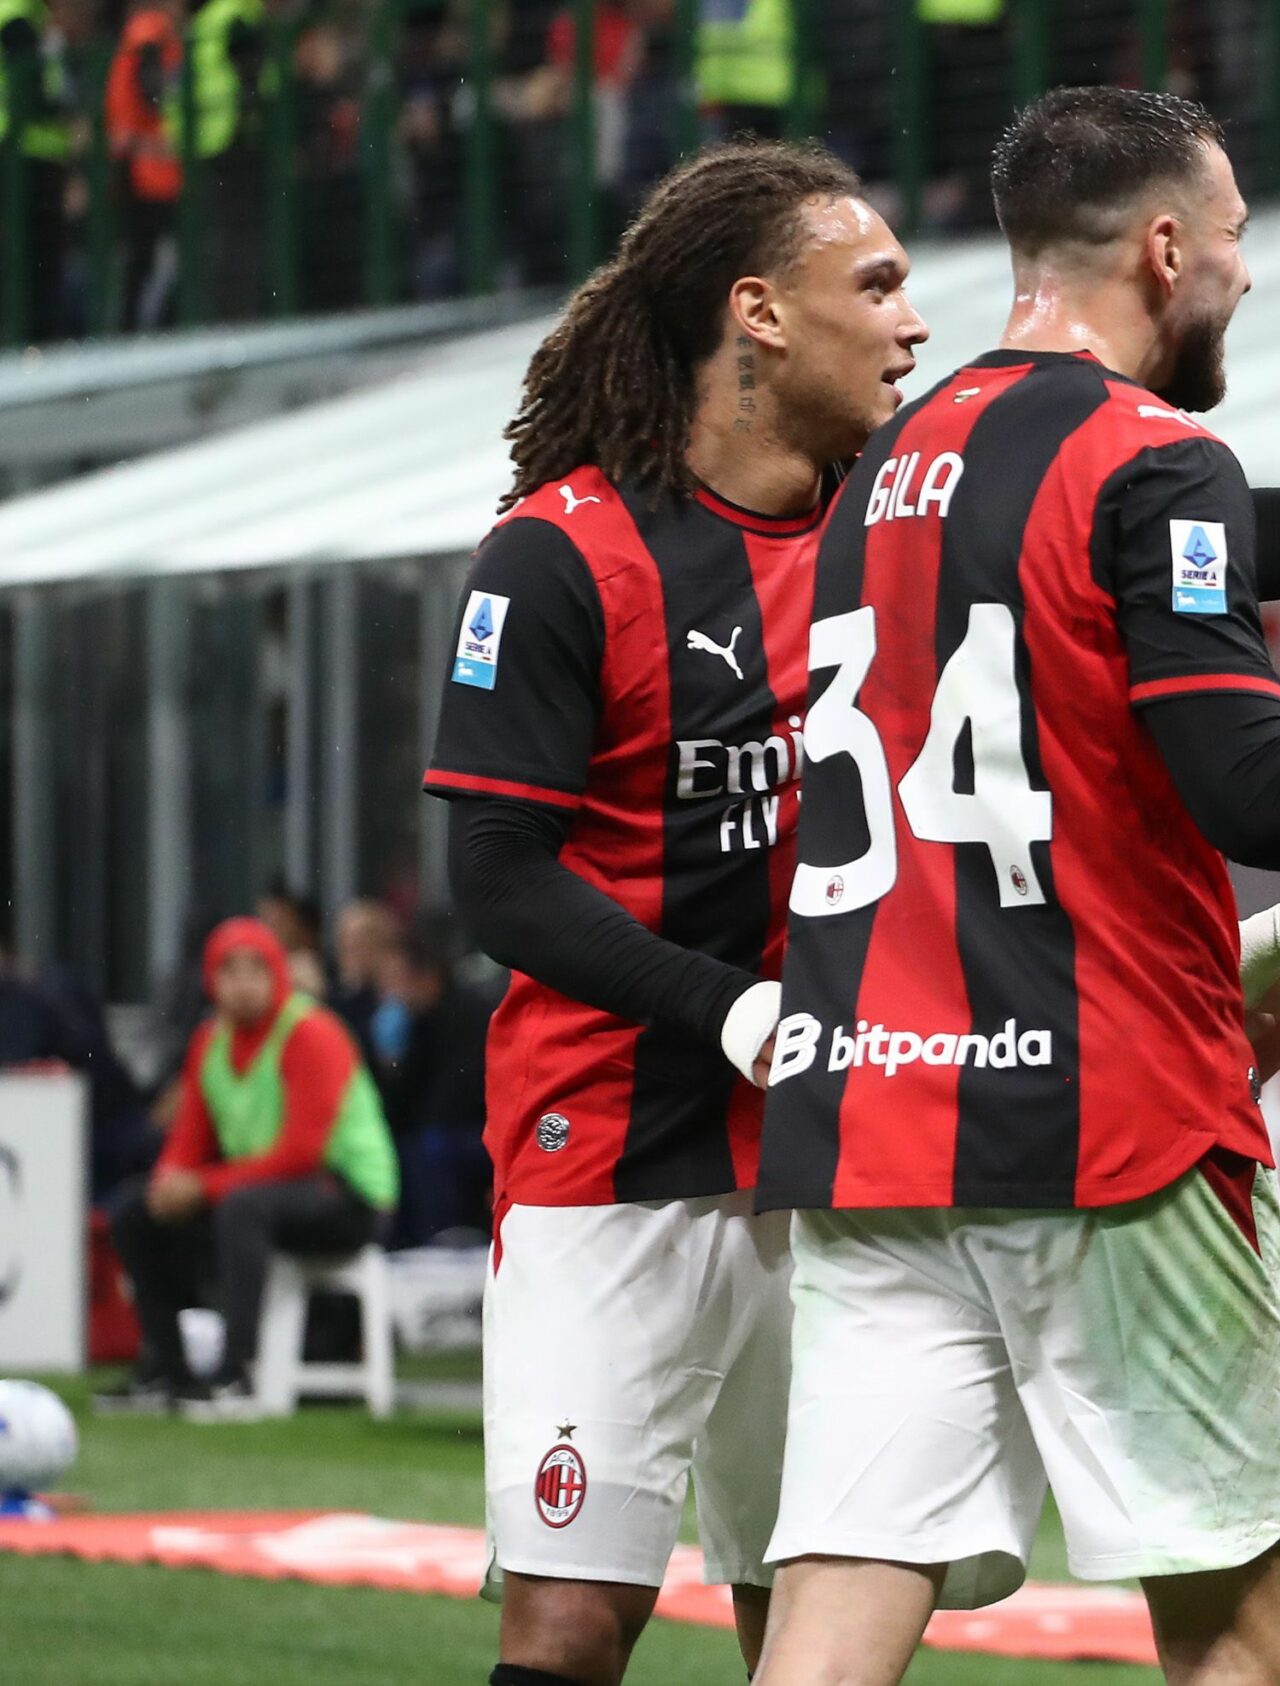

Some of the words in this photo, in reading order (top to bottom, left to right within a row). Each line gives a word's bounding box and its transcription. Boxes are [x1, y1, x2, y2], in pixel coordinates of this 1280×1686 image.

[864, 451, 964, 526] GILA
[1181, 569, 1208, 580] SERIE
[1209, 571, 1217, 581] A
[788, 603, 1052, 917] 34
[720, 795, 779, 852] FLY
[828, 1018, 1052, 1077] bitpanda
